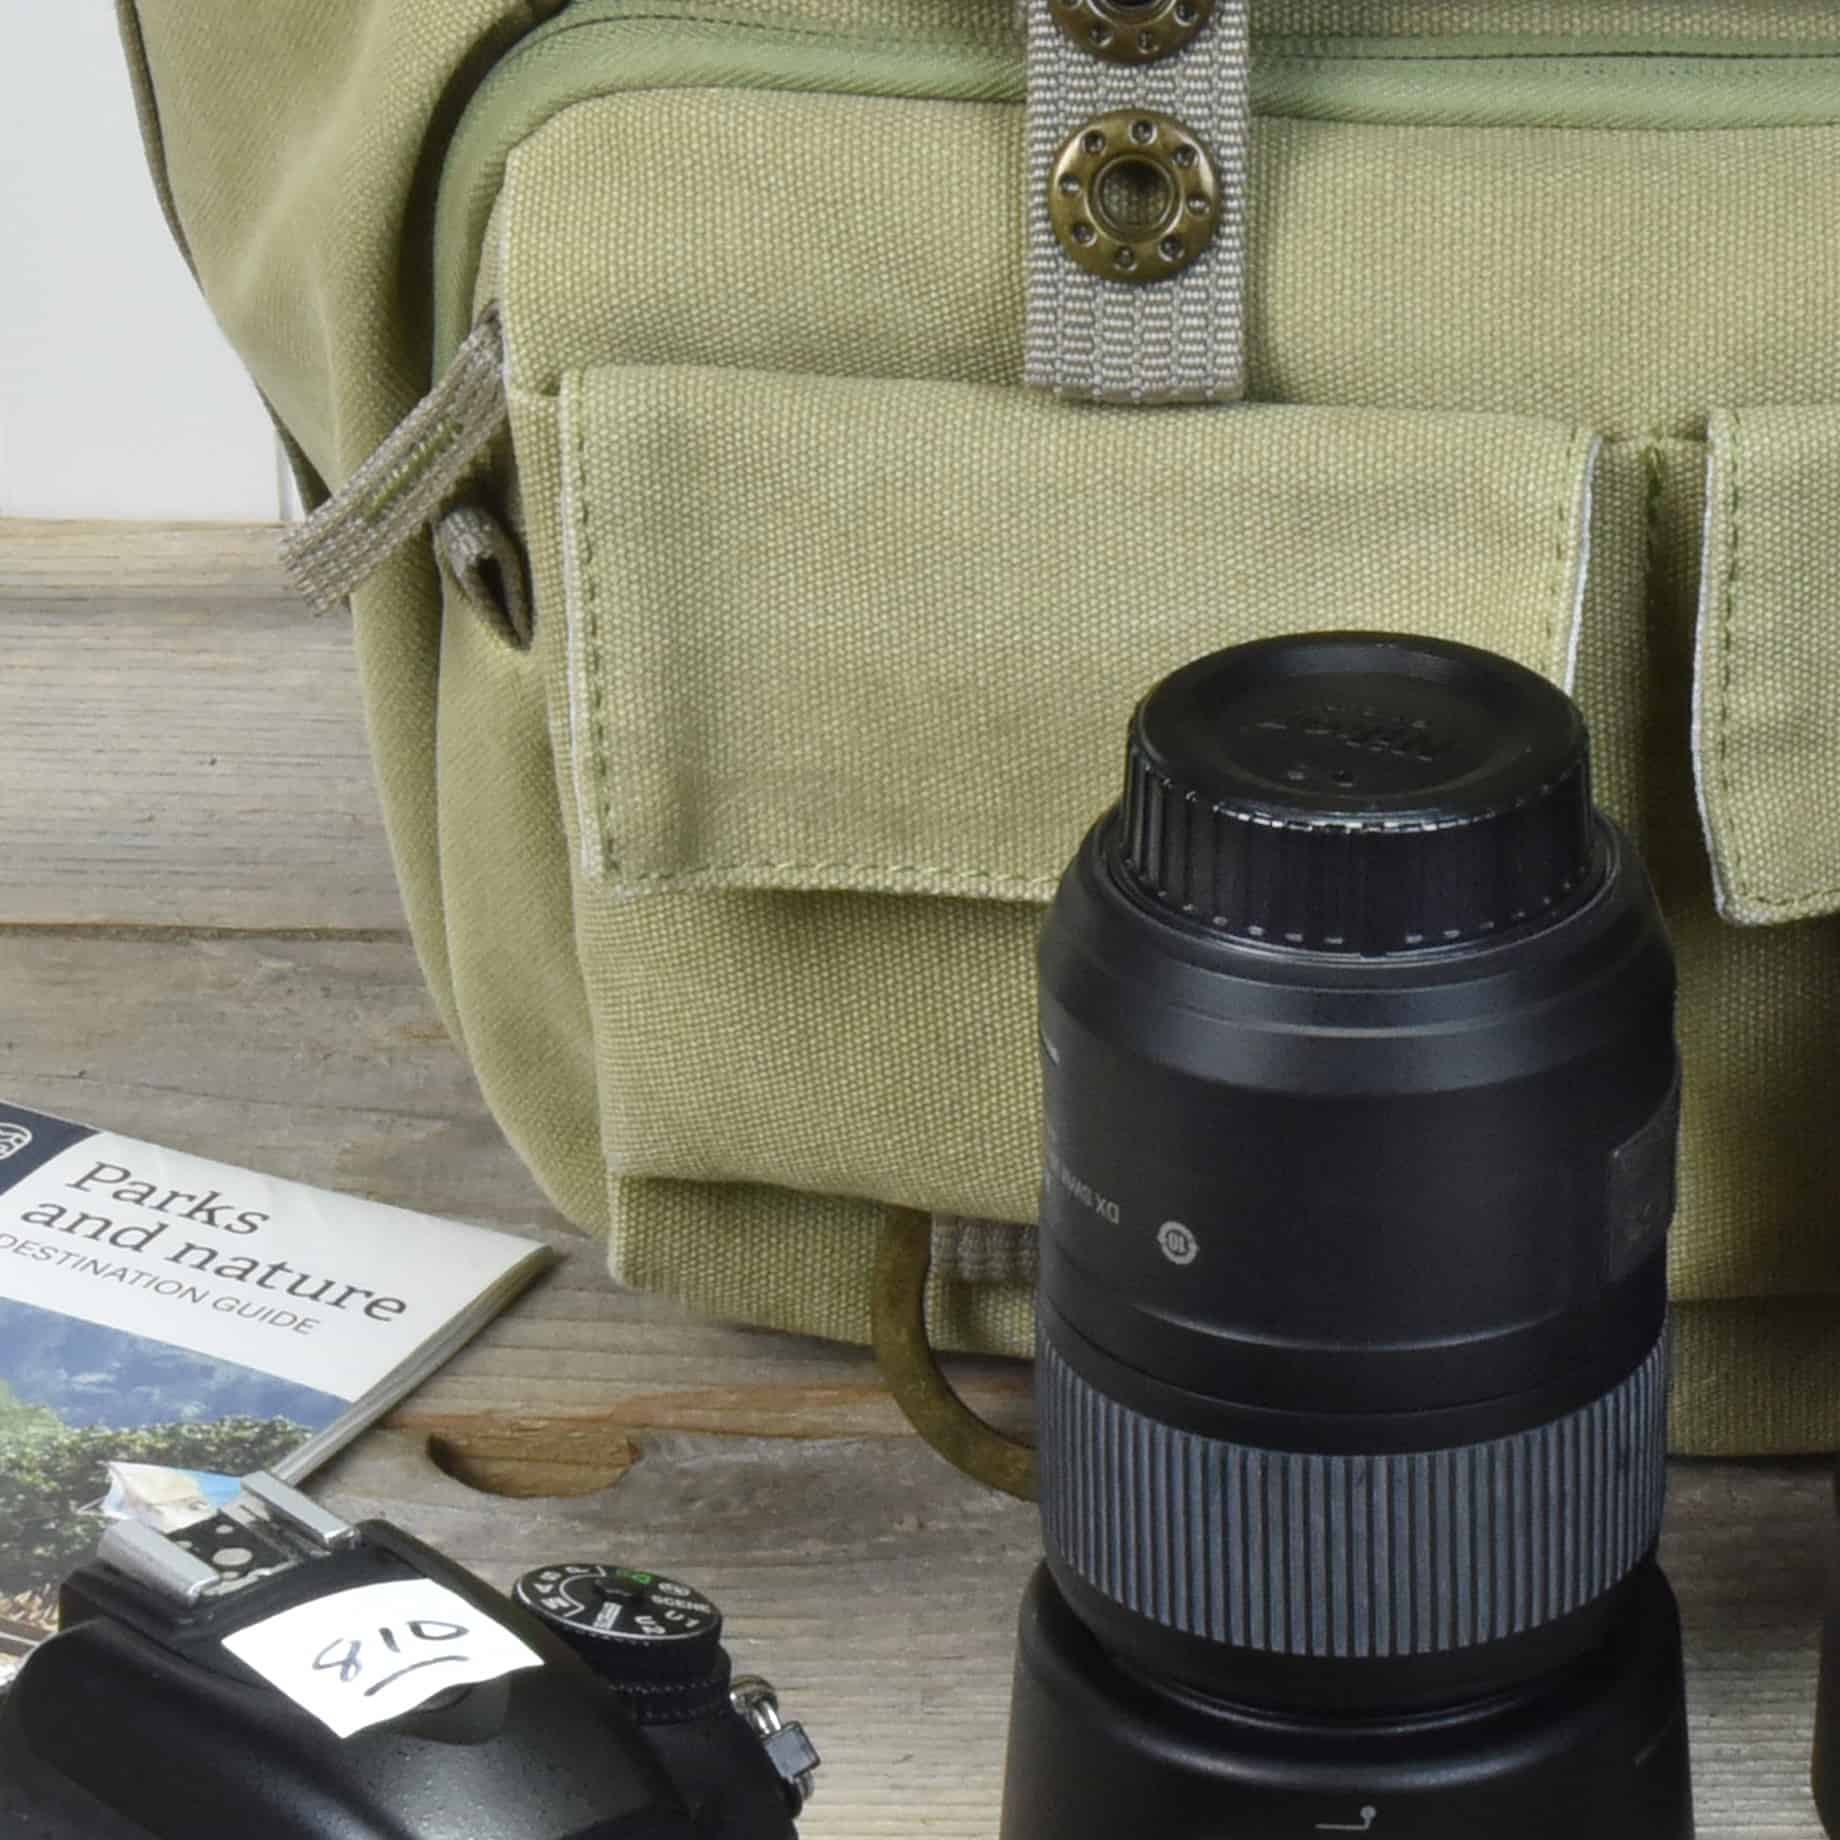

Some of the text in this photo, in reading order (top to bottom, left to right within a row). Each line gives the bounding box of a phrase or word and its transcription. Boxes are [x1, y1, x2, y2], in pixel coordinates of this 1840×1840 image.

[65, 1161, 270, 1235] Parks
[0, 1233, 320, 1335] DESTINATION GUIDE
[21, 1201, 407, 1322] and nature
[312, 1619, 471, 1683] 810
